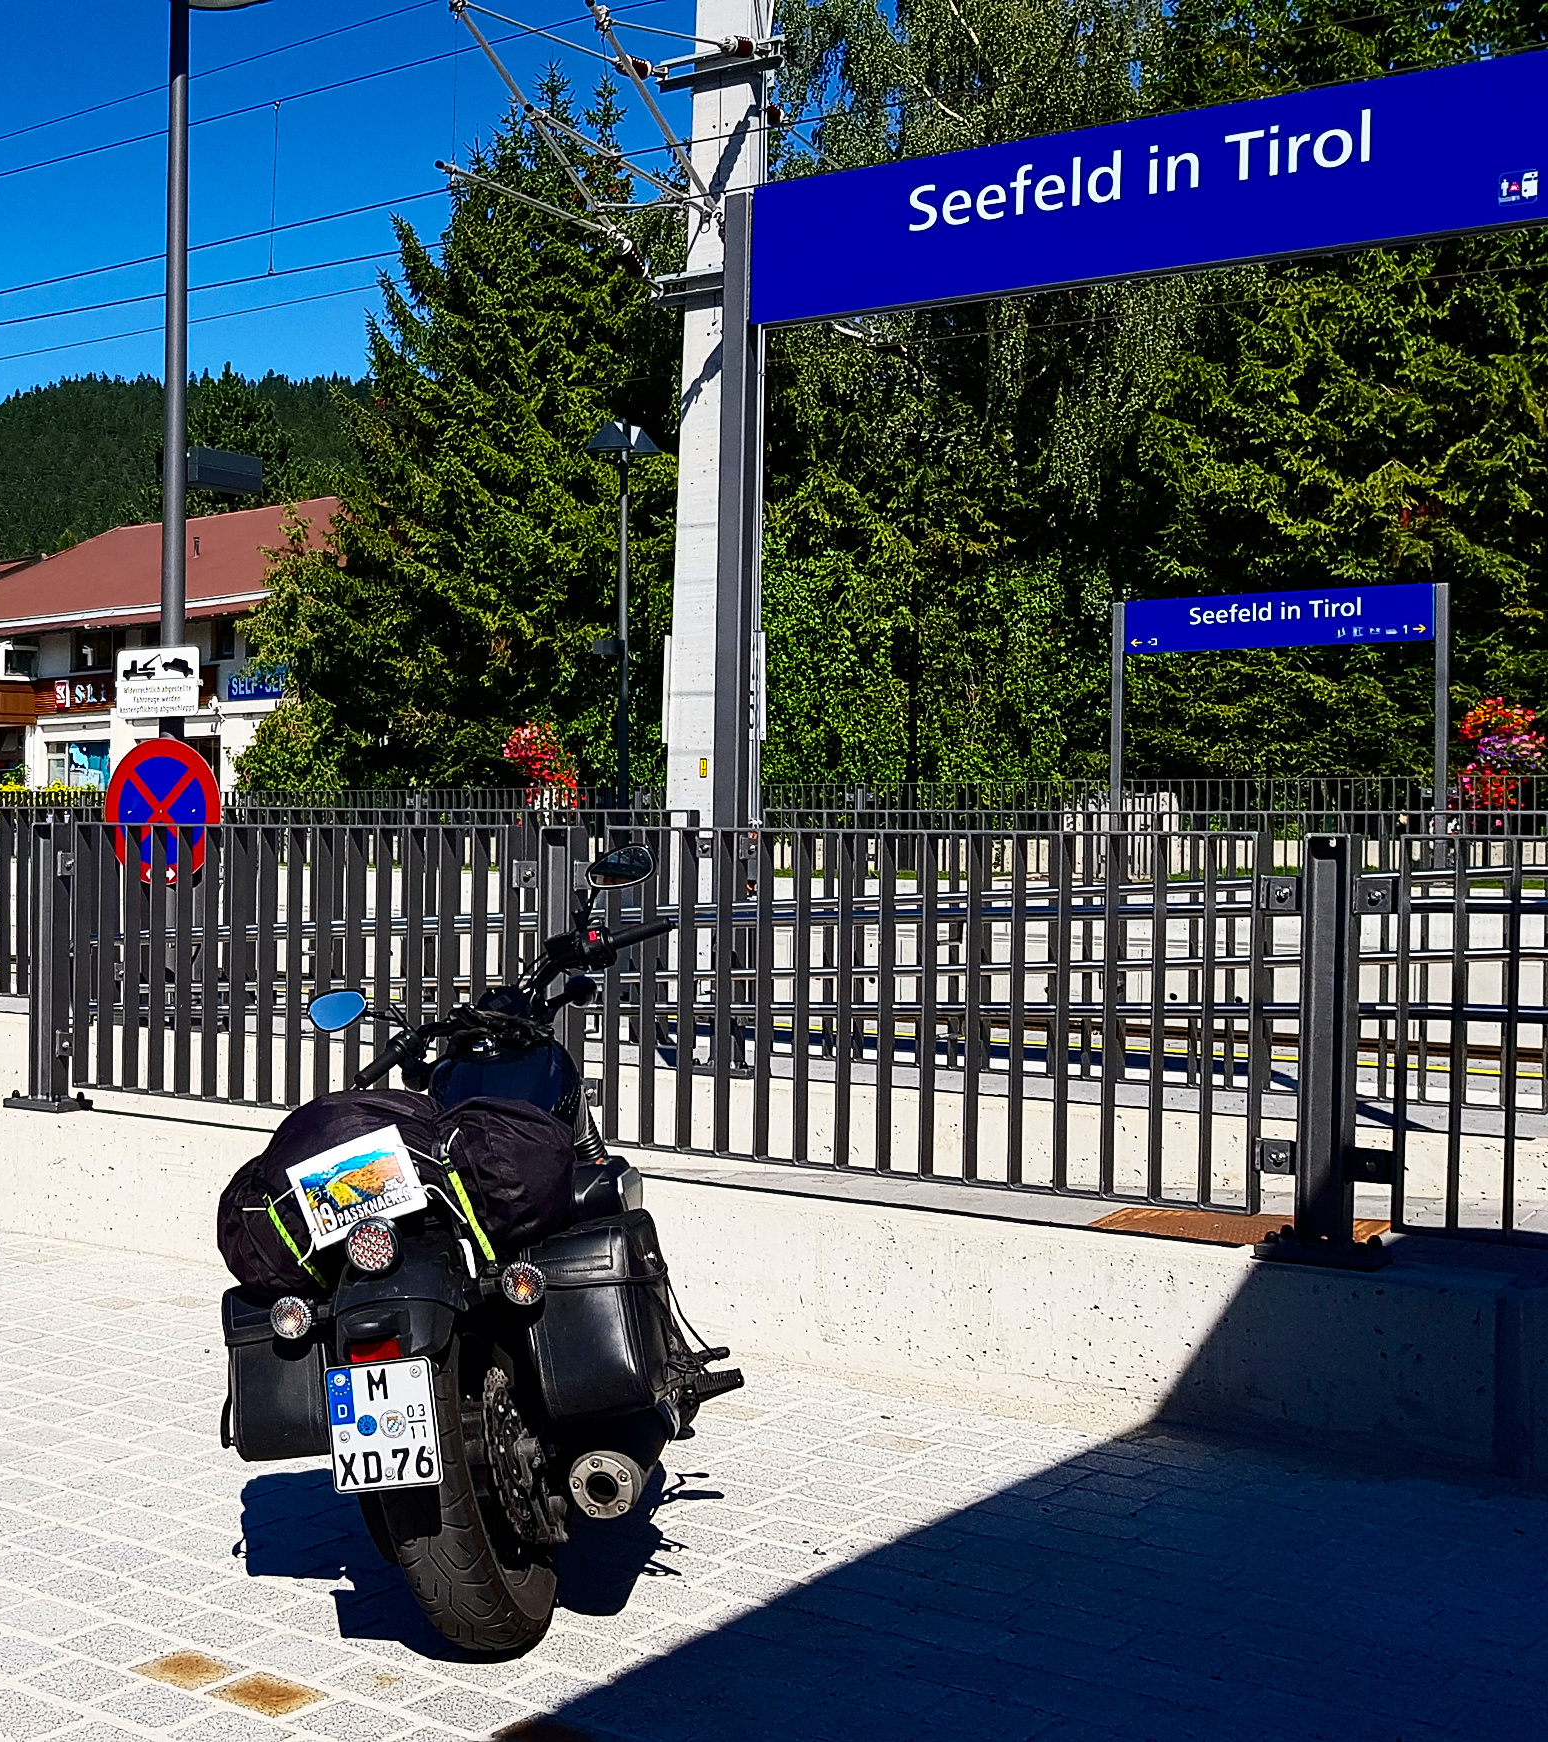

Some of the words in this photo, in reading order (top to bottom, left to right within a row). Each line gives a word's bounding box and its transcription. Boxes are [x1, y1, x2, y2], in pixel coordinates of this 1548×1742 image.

[908, 150, 1121, 231] Seefeld
[1148, 145, 1200, 195] in
[1224, 108, 1371, 181] Tirol
[1189, 602, 1272, 625] Seefeld
[1280, 602, 1301, 620] in
[1309, 597, 1362, 618] Tirol
[1402, 625, 1408, 634] 1
[312, 1202, 338, 1237] 19
[366, 1368, 389, 1401] M
[337, 1404, 348, 1418] D
[406, 1403, 426, 1418] 03
[410, 1424, 427, 1439] 11
